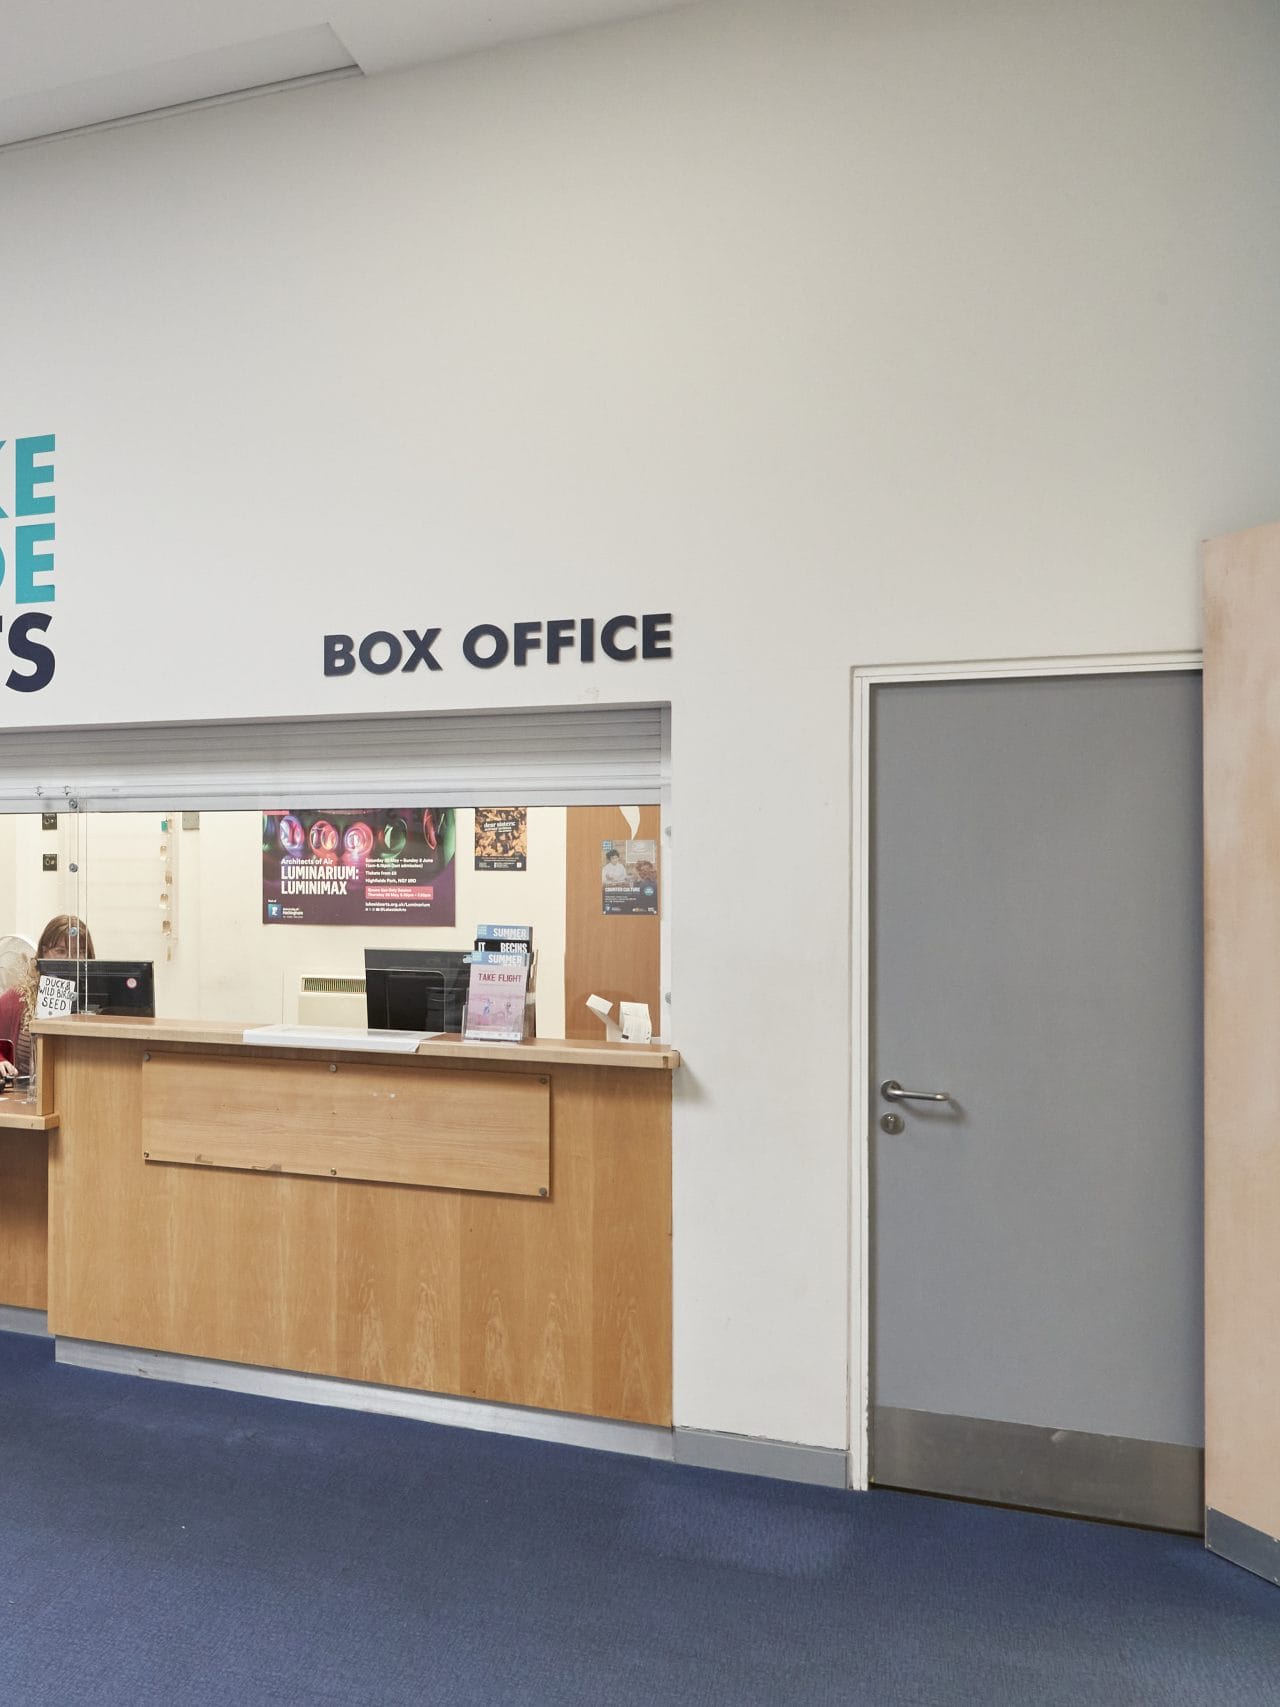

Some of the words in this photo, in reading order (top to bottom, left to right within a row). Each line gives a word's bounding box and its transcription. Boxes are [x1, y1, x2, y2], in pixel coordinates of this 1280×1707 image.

[324, 627, 443, 677] BOX
[462, 613, 673, 669] OFFICE
[281, 866, 359, 880] LUMINARIUM:
[281, 881, 347, 895] LUMINIMAX
[493, 928, 527, 938] SUMMER
[478, 942, 486, 952] IT
[500, 942, 528, 954] BEGINS
[488, 954, 523, 964] SUMMER
[45, 978, 64, 990] DUCK
[478, 974, 496, 982] TAKE
[498, 974, 522, 982] FLIGHT
[38, 985, 54, 997] WILD
[42, 997, 66, 1011] SEED
